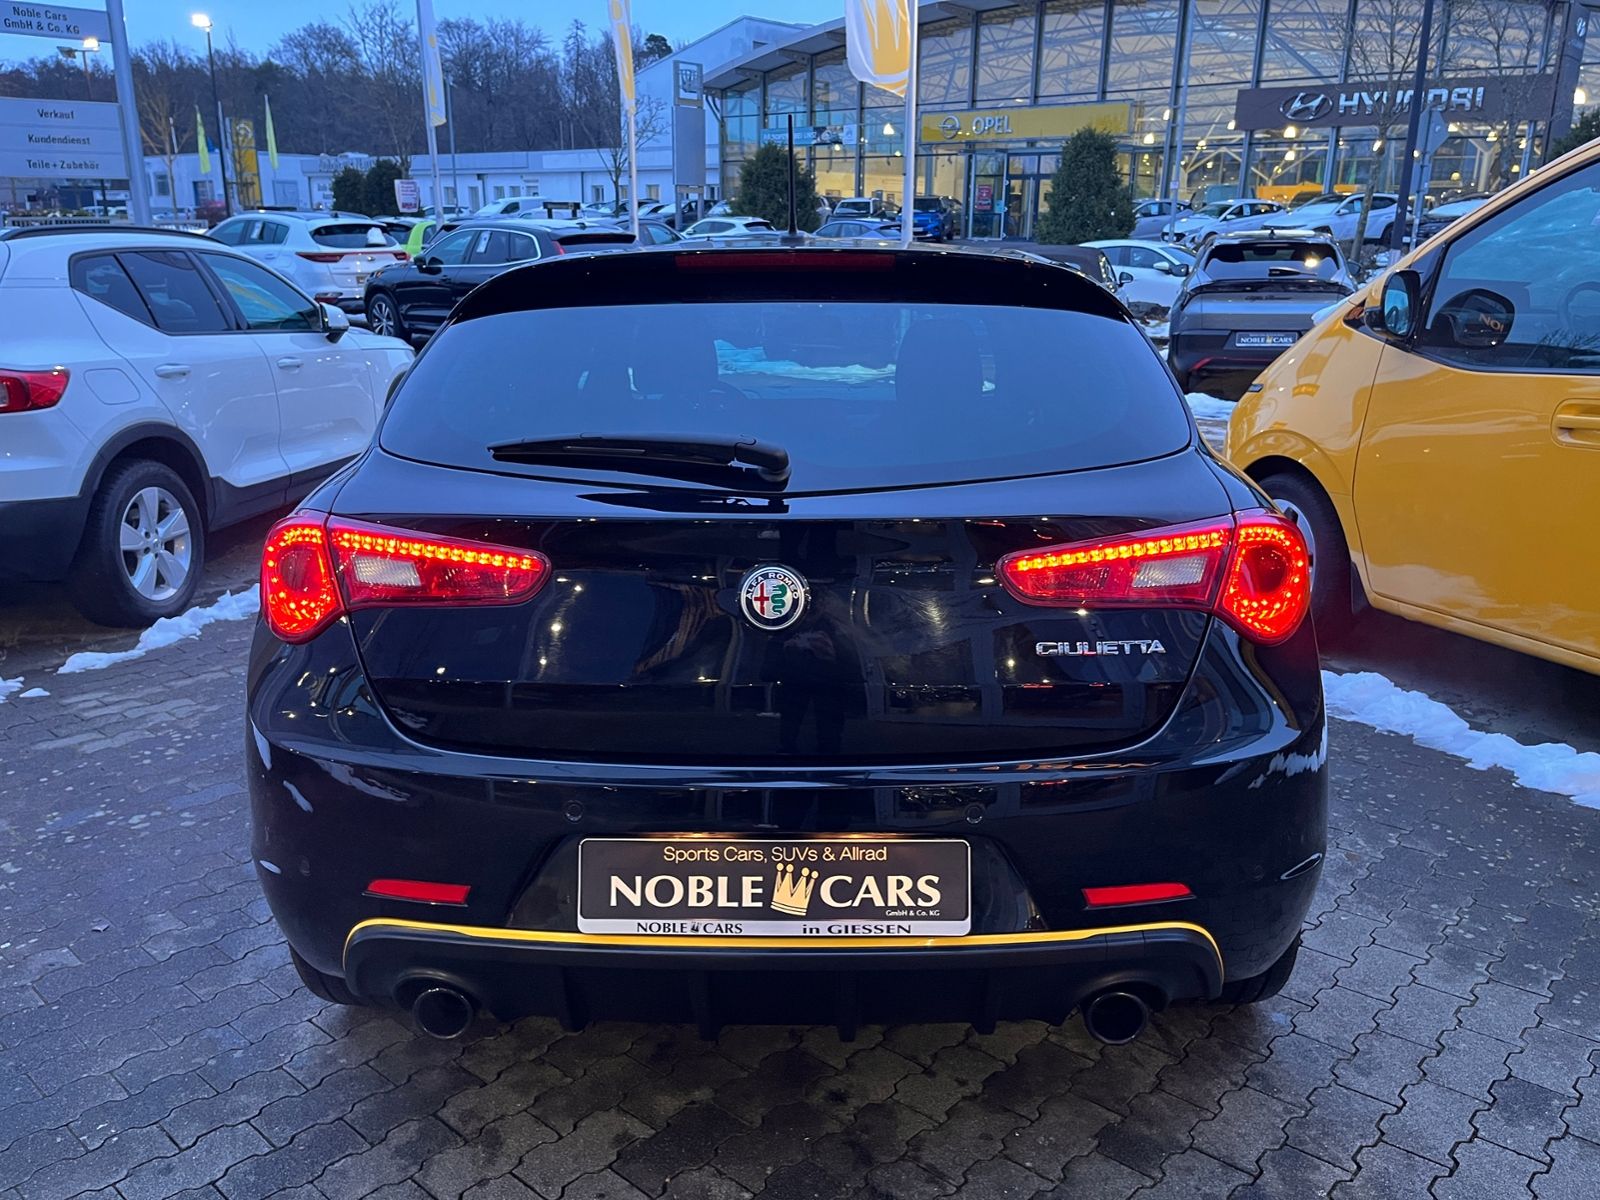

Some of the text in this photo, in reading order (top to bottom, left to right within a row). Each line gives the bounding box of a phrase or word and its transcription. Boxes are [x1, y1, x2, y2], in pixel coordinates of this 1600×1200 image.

[12, 6, 68, 21] Noble Cars
[4, 18, 80, 35] GmbH & Co. KG
[37, 109, 75, 120] Verkauf
[972, 115, 1013, 135] OPEL
[28, 134, 91, 146] Kundendienst
[27, 159, 50, 170] Teile
[60, 160, 100, 170] Zubehör
[1241, 336, 1293, 344] NOBLE CARS
[746, 572, 799, 600] ALFA ROMEO
[1035, 639, 1167, 657] GIULIETTA
[663, 846, 888, 864] Sports Cars, SUVs & Allrad
[609, 874, 942, 908] NOBLE CARS
[885, 909, 908, 917] GmbH
[636, 922, 743, 934] NOBLE CARS
[802, 923, 912, 934] in GIESSEN
